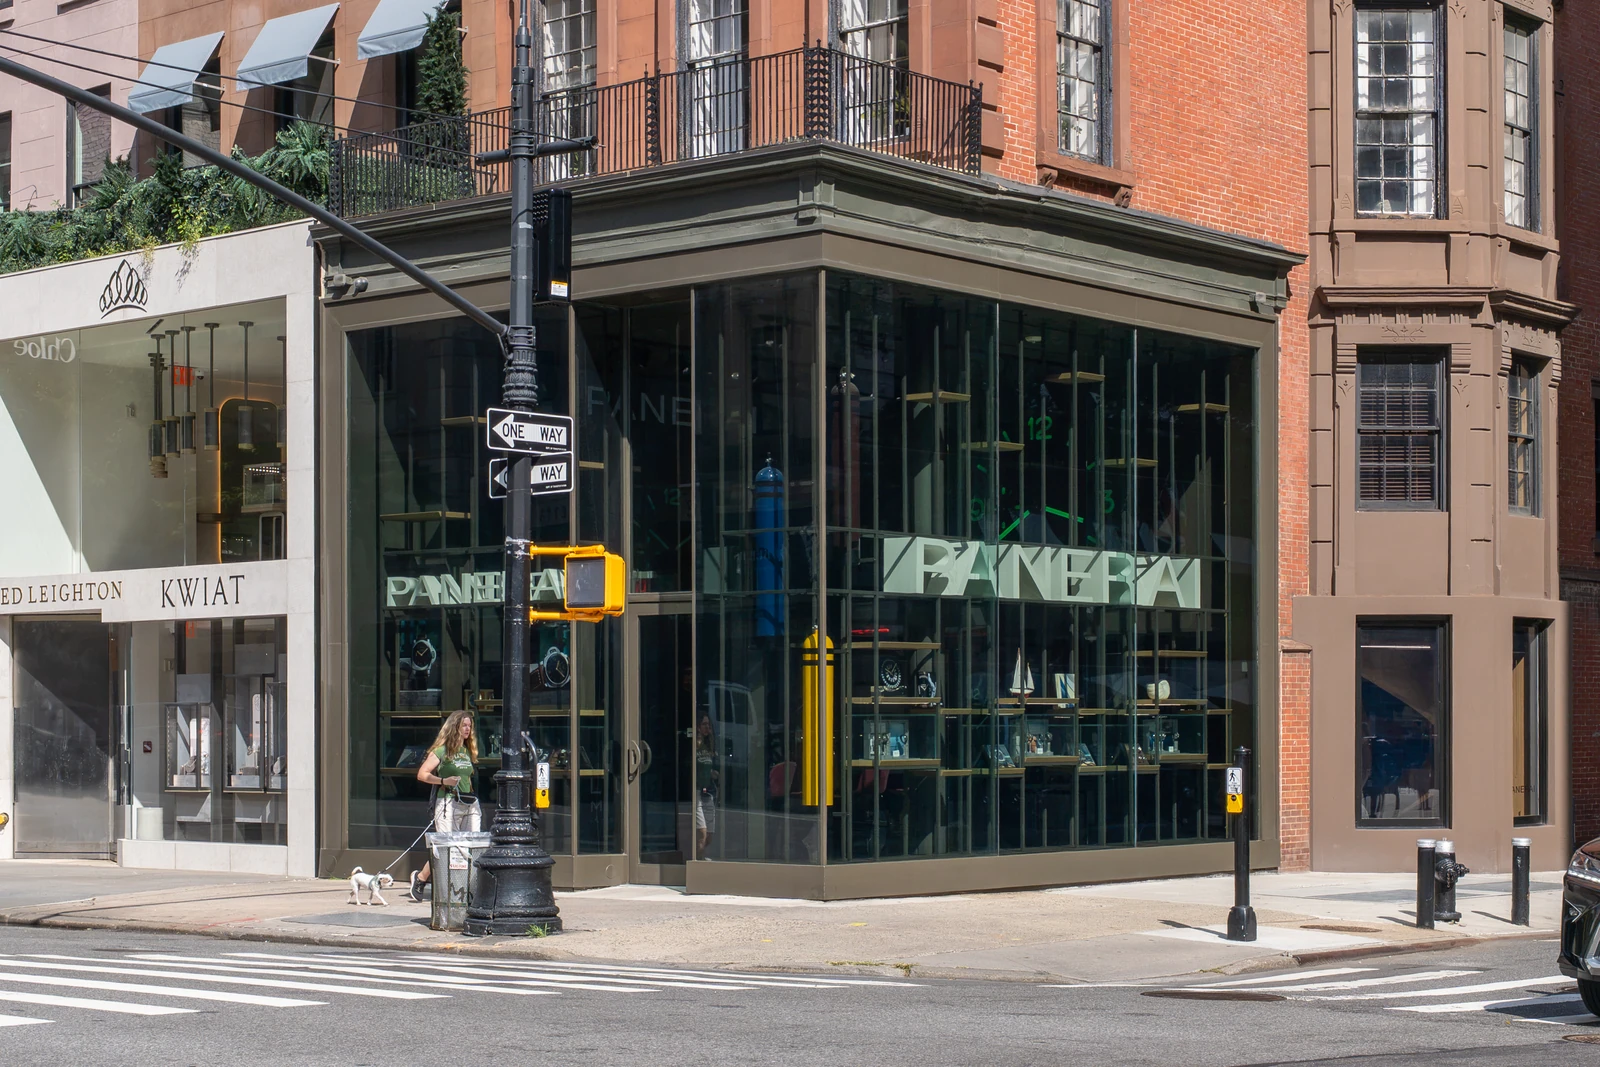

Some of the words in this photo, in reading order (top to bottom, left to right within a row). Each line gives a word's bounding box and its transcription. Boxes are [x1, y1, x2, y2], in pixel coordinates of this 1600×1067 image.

[502, 423, 525, 439] ONE
[540, 426, 564, 443] WAY
[1027, 416, 1053, 440] 12
[540, 464, 564, 481] WAY
[0, 587, 23, 606] ED
[28, 580, 123, 604] LEIGHTON
[161, 575, 245, 608] KWIAT
